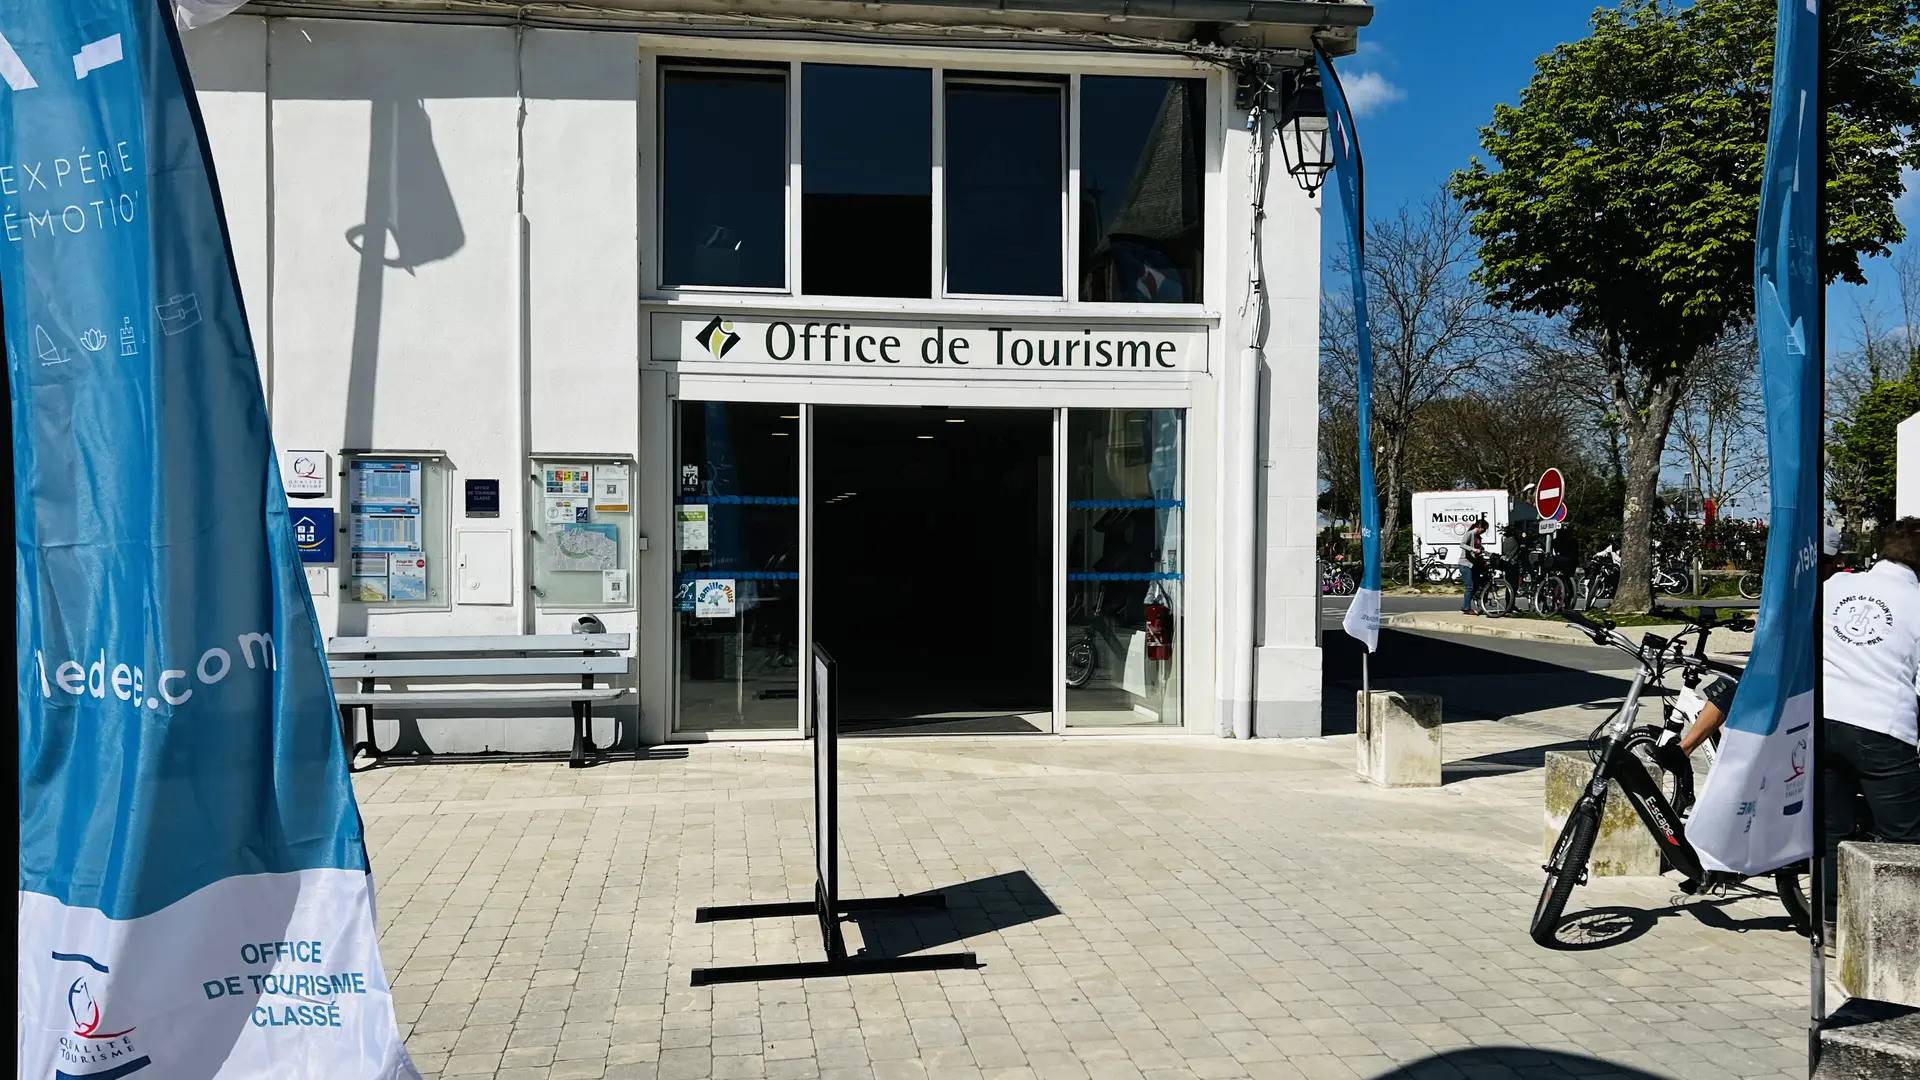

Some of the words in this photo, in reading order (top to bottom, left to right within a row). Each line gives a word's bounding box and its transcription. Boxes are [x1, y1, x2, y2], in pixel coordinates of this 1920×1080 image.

[4, 190, 139, 242] ÉMOTIO
[765, 321, 900, 362] Office
[920, 326, 970, 364] de
[988, 326, 1176, 368] Tourisme
[697, 581, 724, 603] Famille
[723, 584, 734, 604] Plus
[1875, 599, 1894, 627] COUNTRY
[1645, 795, 1675, 837] E-scape
[240, 941, 322, 965] OFFICE
[203, 976, 244, 1000] DE
[247, 973, 366, 996] TOURISME
[251, 1001, 342, 1028] CLASSÉ
[60, 1045, 135, 1064] TOURISME
